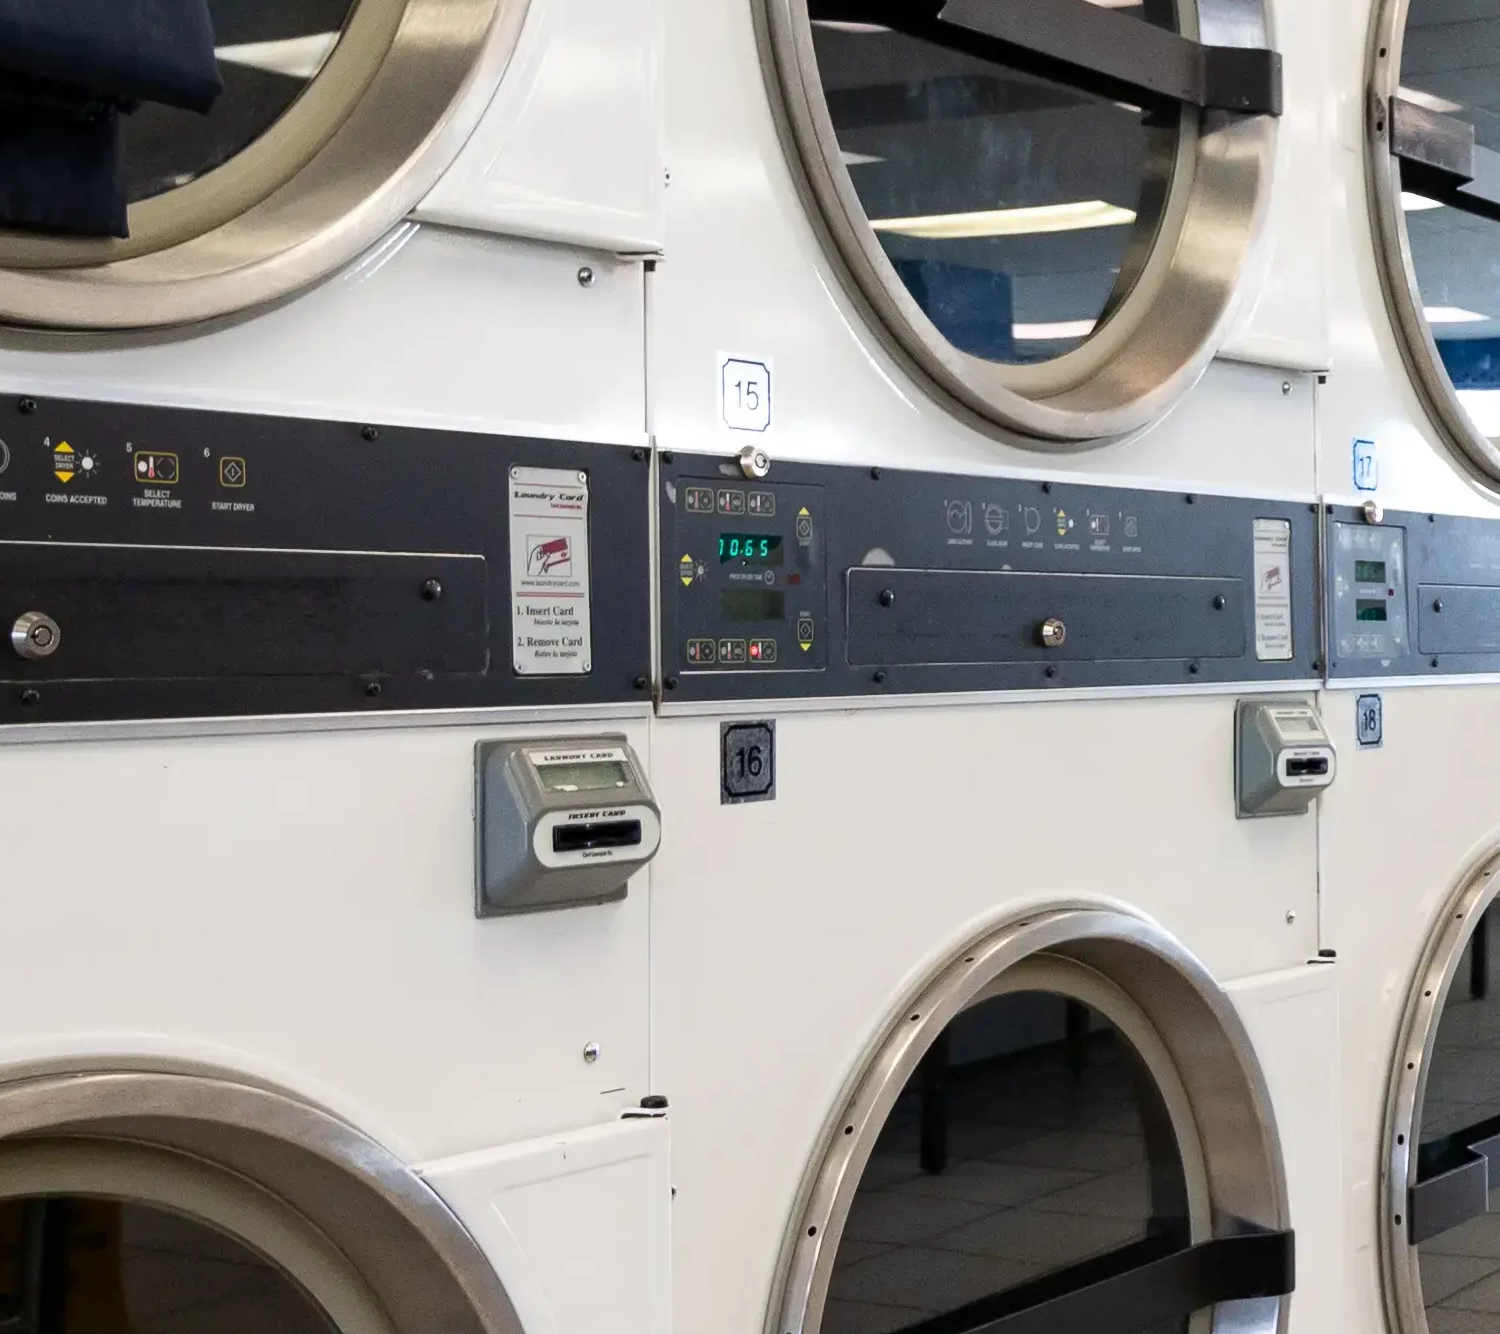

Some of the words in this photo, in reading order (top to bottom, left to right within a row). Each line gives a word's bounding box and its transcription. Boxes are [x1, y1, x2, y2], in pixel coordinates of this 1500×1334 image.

[733, 379, 760, 412] 15
[43, 436, 50, 447] 4
[126, 442, 133, 453] 5
[203, 447, 210, 458] 6
[45, 494, 68, 504] COINS
[68, 495, 108, 505] ACCEPTED
[144, 490, 171, 499] SELECT
[514, 491, 555, 501] Laundry
[559, 493, 584, 502] Card
[132, 498, 182, 509] TEMPERATURE
[211, 502, 232, 511] START
[516, 605, 524, 616] 1.
[526, 605, 550, 616] Insert
[552, 605, 574, 616] Card
[527, 636, 560, 647] Remove
[561, 636, 583, 647] Card
[1363, 709, 1377, 731] 18
[734, 745, 762, 778] 16
